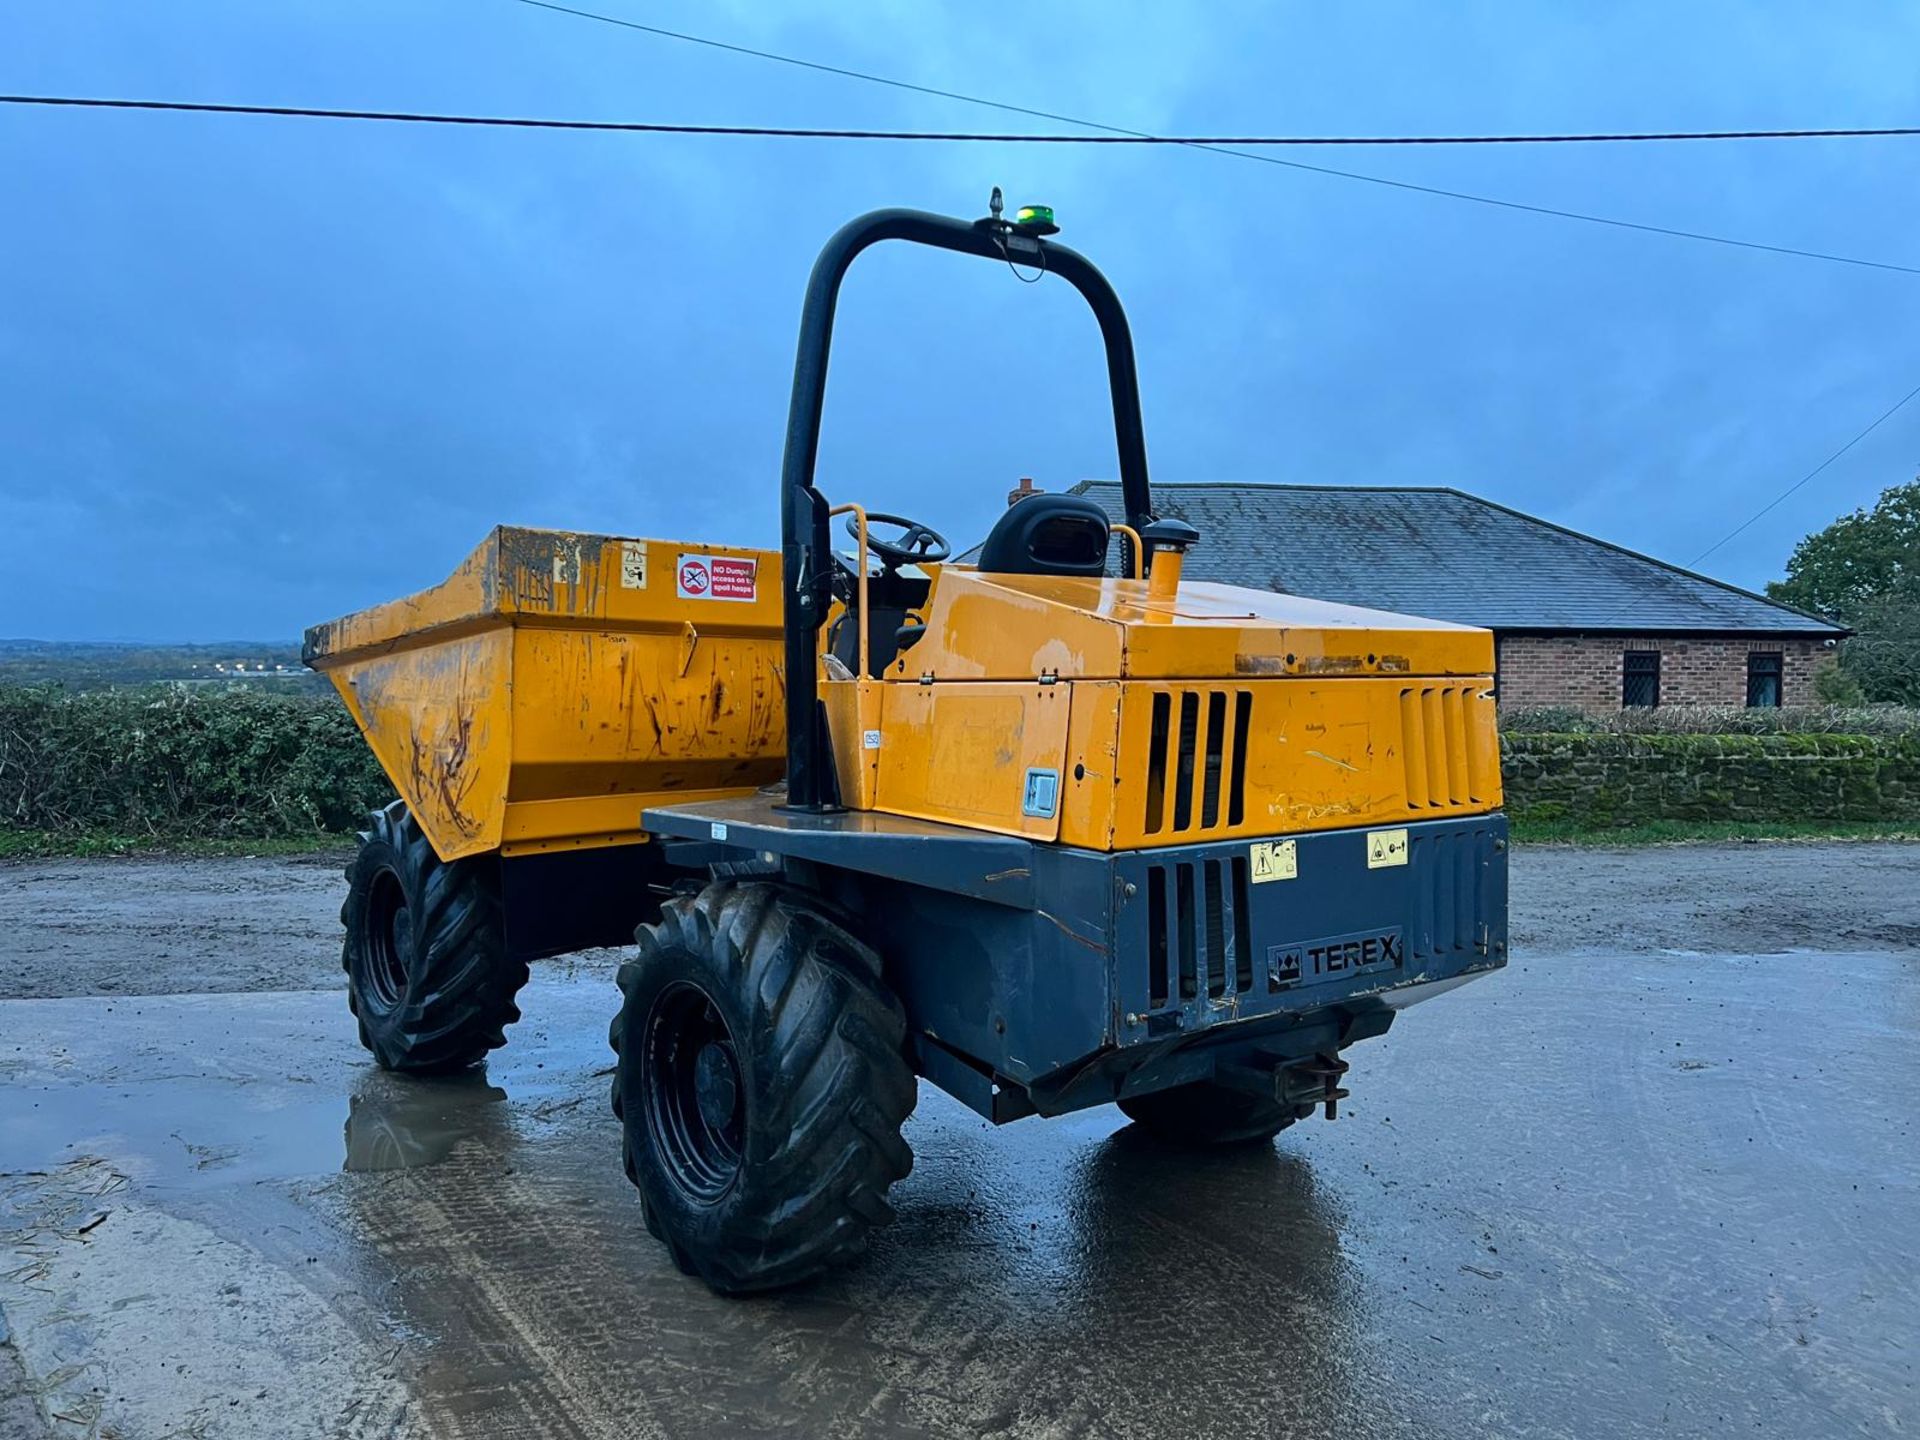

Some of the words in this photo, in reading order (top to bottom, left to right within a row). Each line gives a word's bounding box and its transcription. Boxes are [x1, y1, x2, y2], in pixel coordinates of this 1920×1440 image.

[713, 566, 725, 574] NO
[725, 567, 752, 576] Dumpe
[713, 584, 730, 592] spoil
[731, 585, 752, 593] heaps
[1307, 934, 1397, 975] TEREX
